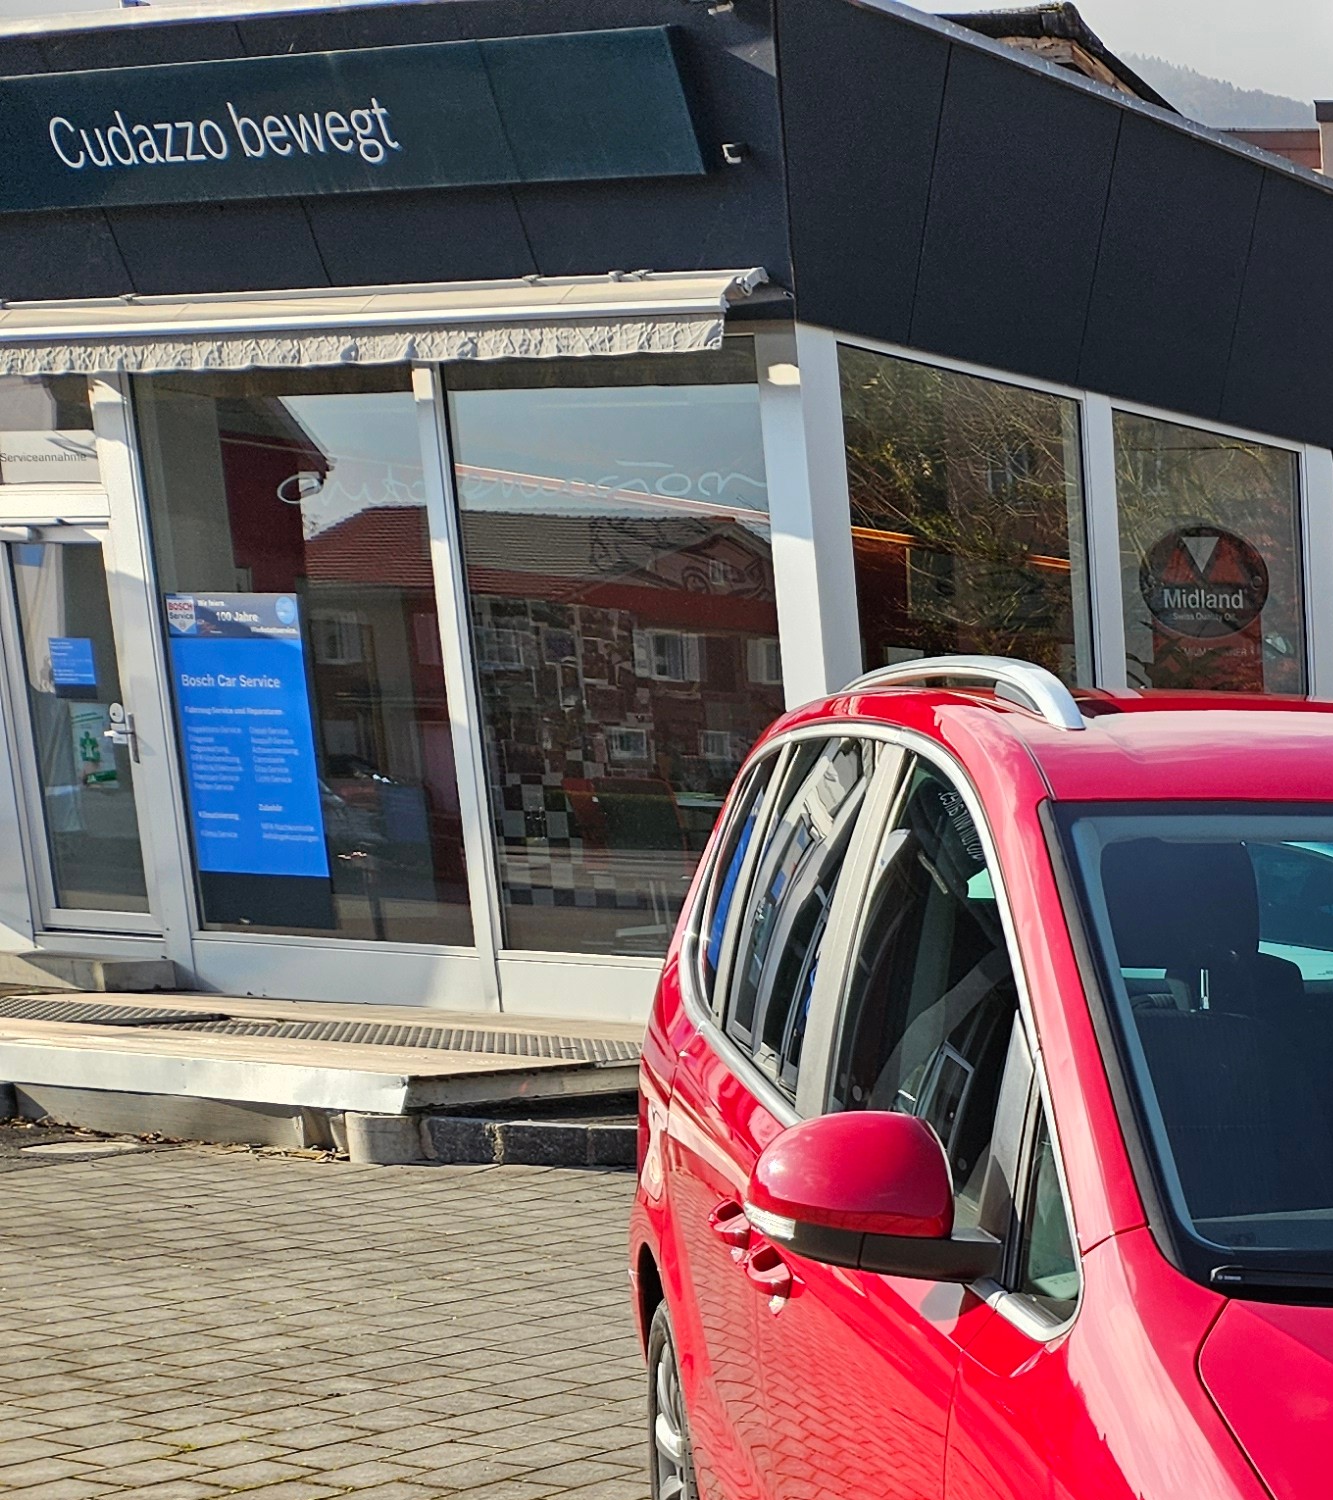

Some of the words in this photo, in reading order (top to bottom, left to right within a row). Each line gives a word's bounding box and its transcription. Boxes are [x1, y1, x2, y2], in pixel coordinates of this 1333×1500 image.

[48, 110, 229, 170] Cudazzo
[226, 97, 402, 164] bewegt
[0, 452, 87, 464] Serviceannahme
[1163, 588, 1244, 609] Midland
[168, 602, 193, 611] BOSCH
[169, 611, 194, 620] Service
[215, 611, 233, 622] 100
[233, 611, 259, 623] Jahre
[181, 673, 215, 687] Bosch
[217, 674, 237, 687] Car
[239, 674, 281, 688] Service
